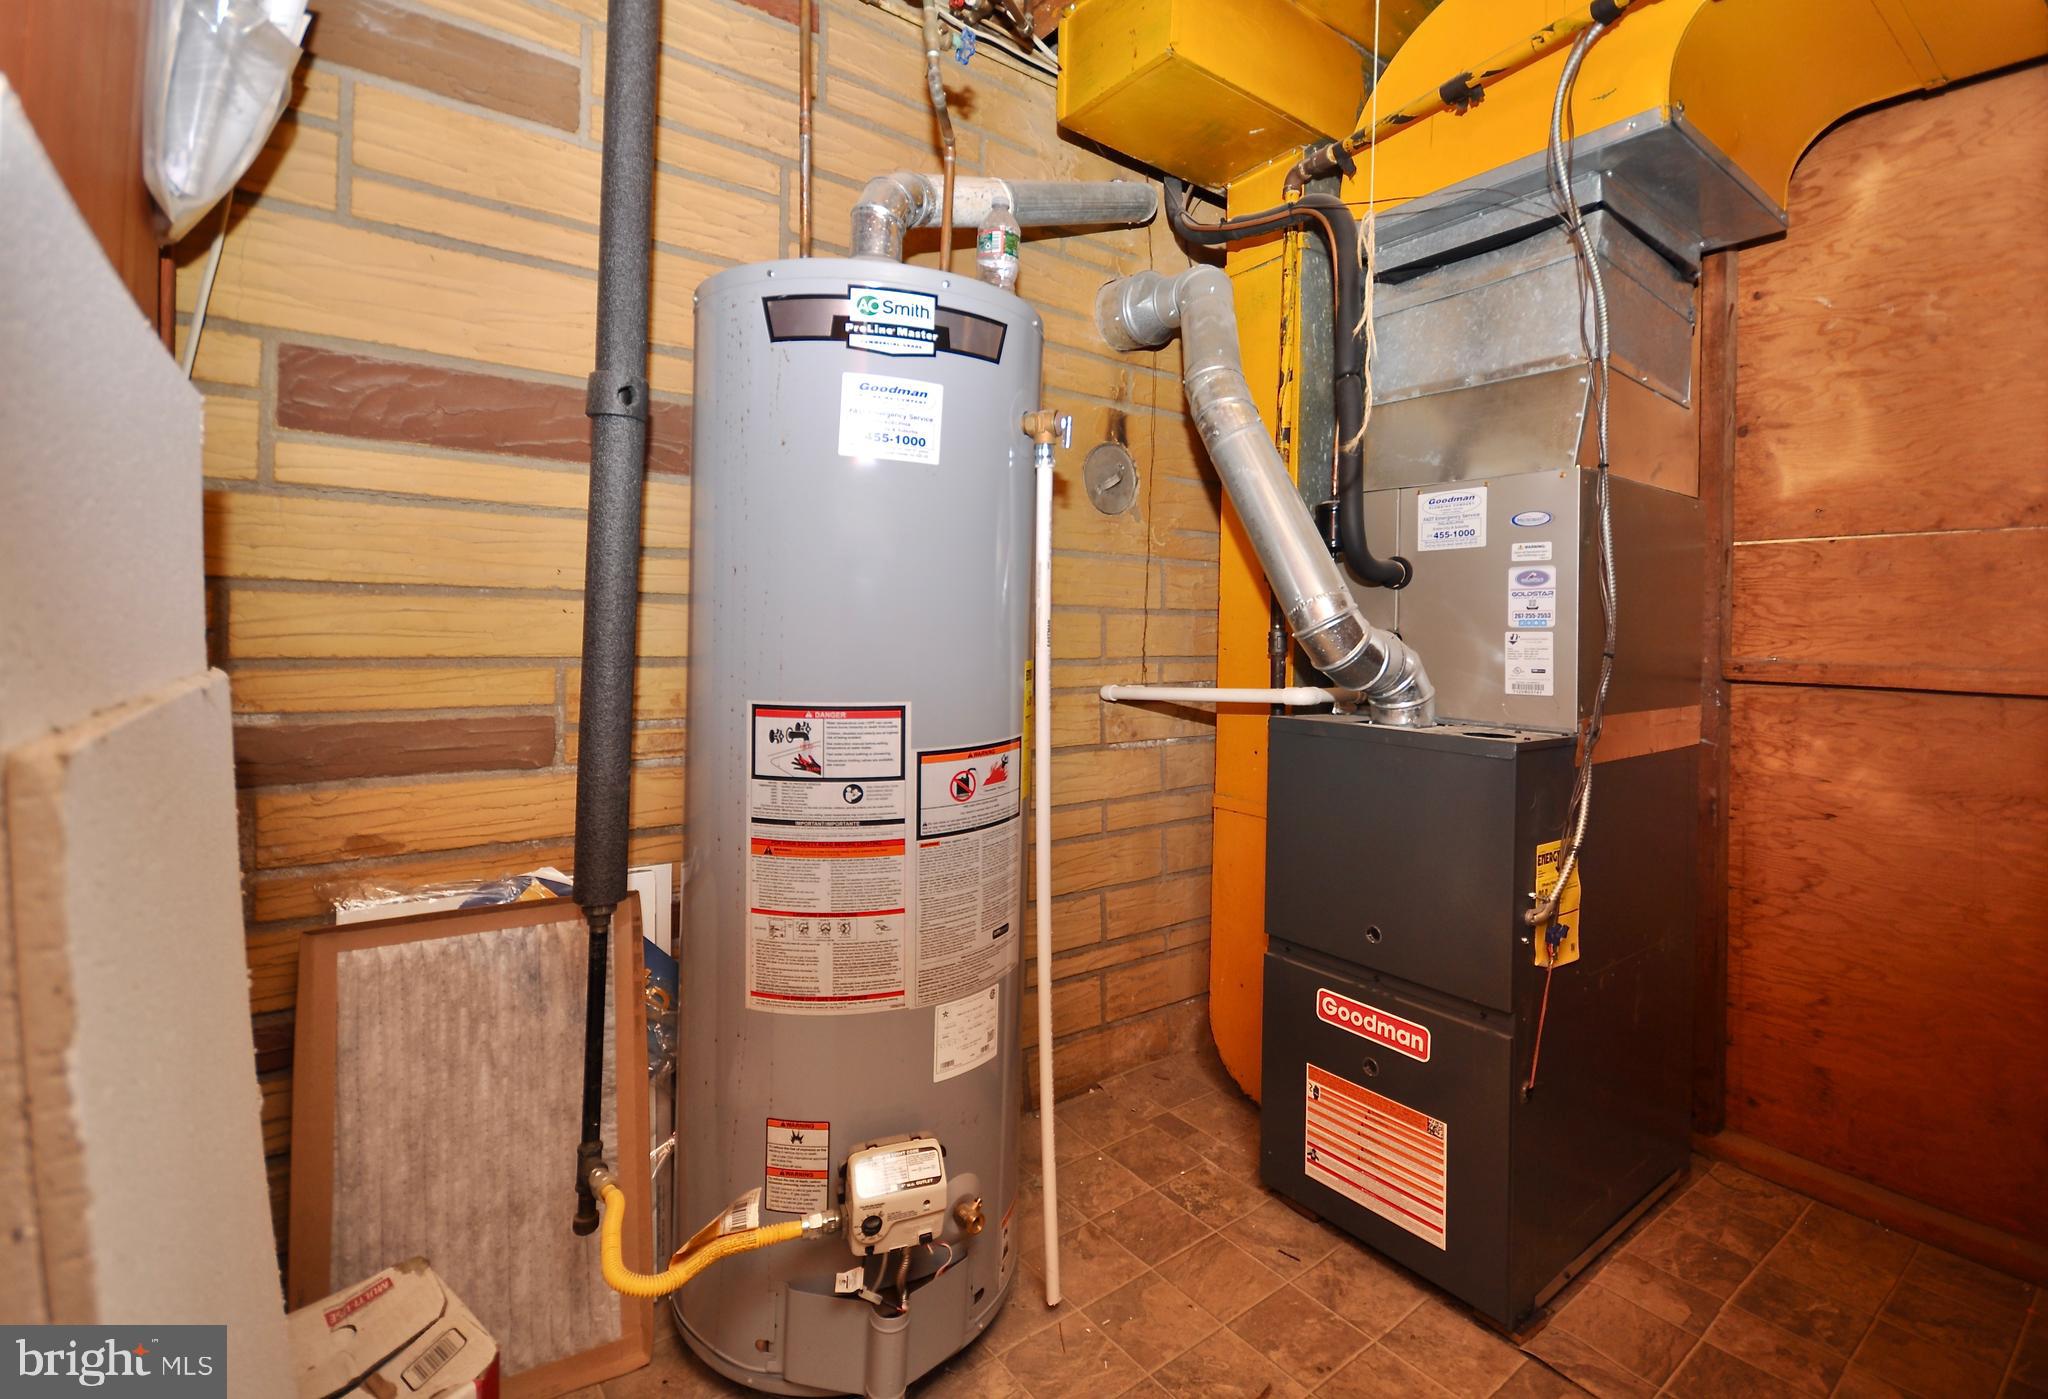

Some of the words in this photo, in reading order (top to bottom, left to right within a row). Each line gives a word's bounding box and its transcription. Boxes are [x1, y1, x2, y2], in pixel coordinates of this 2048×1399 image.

[882, 300, 930, 319] Smith
[845, 322, 895, 335] ProLine
[896, 327, 938, 341] Master
[859, 383, 928, 398] Goodman
[864, 432, 926, 448] 455-1000
[1428, 495, 1475, 505] Goodman
[1433, 529, 1476, 539] 455-1000
[1321, 996, 1424, 1053] Goodman
